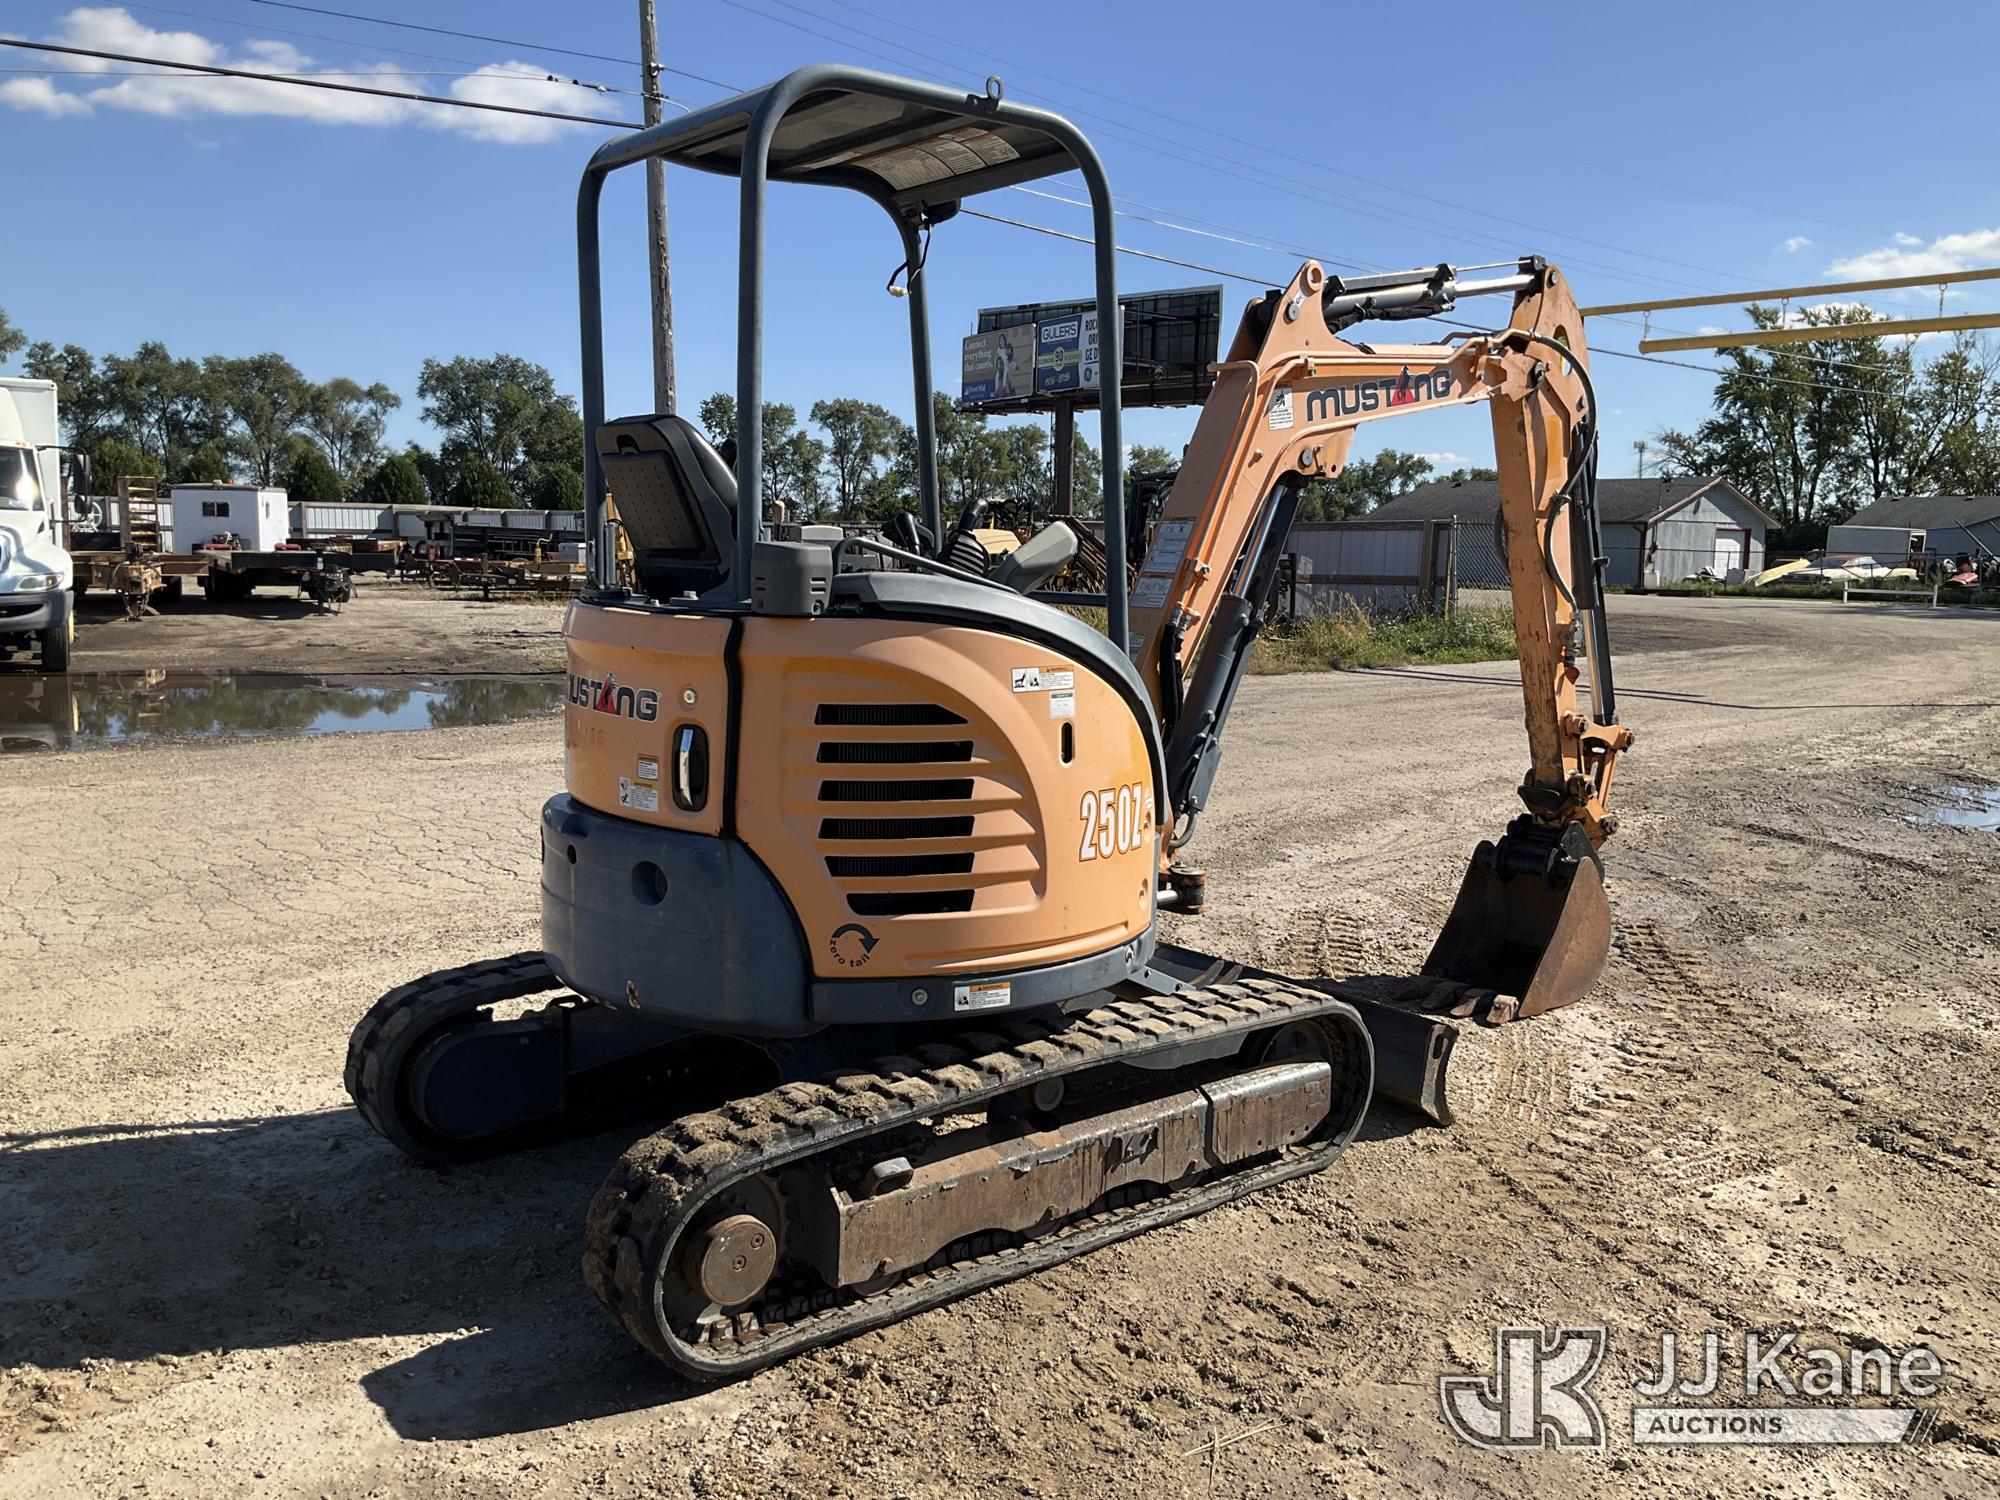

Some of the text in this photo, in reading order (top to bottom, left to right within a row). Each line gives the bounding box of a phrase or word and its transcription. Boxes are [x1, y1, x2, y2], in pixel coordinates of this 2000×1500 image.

[1306, 365, 1451, 422] MUSTANG
[1078, 781, 1143, 863] 250Z
[850, 953, 870, 967] tail
